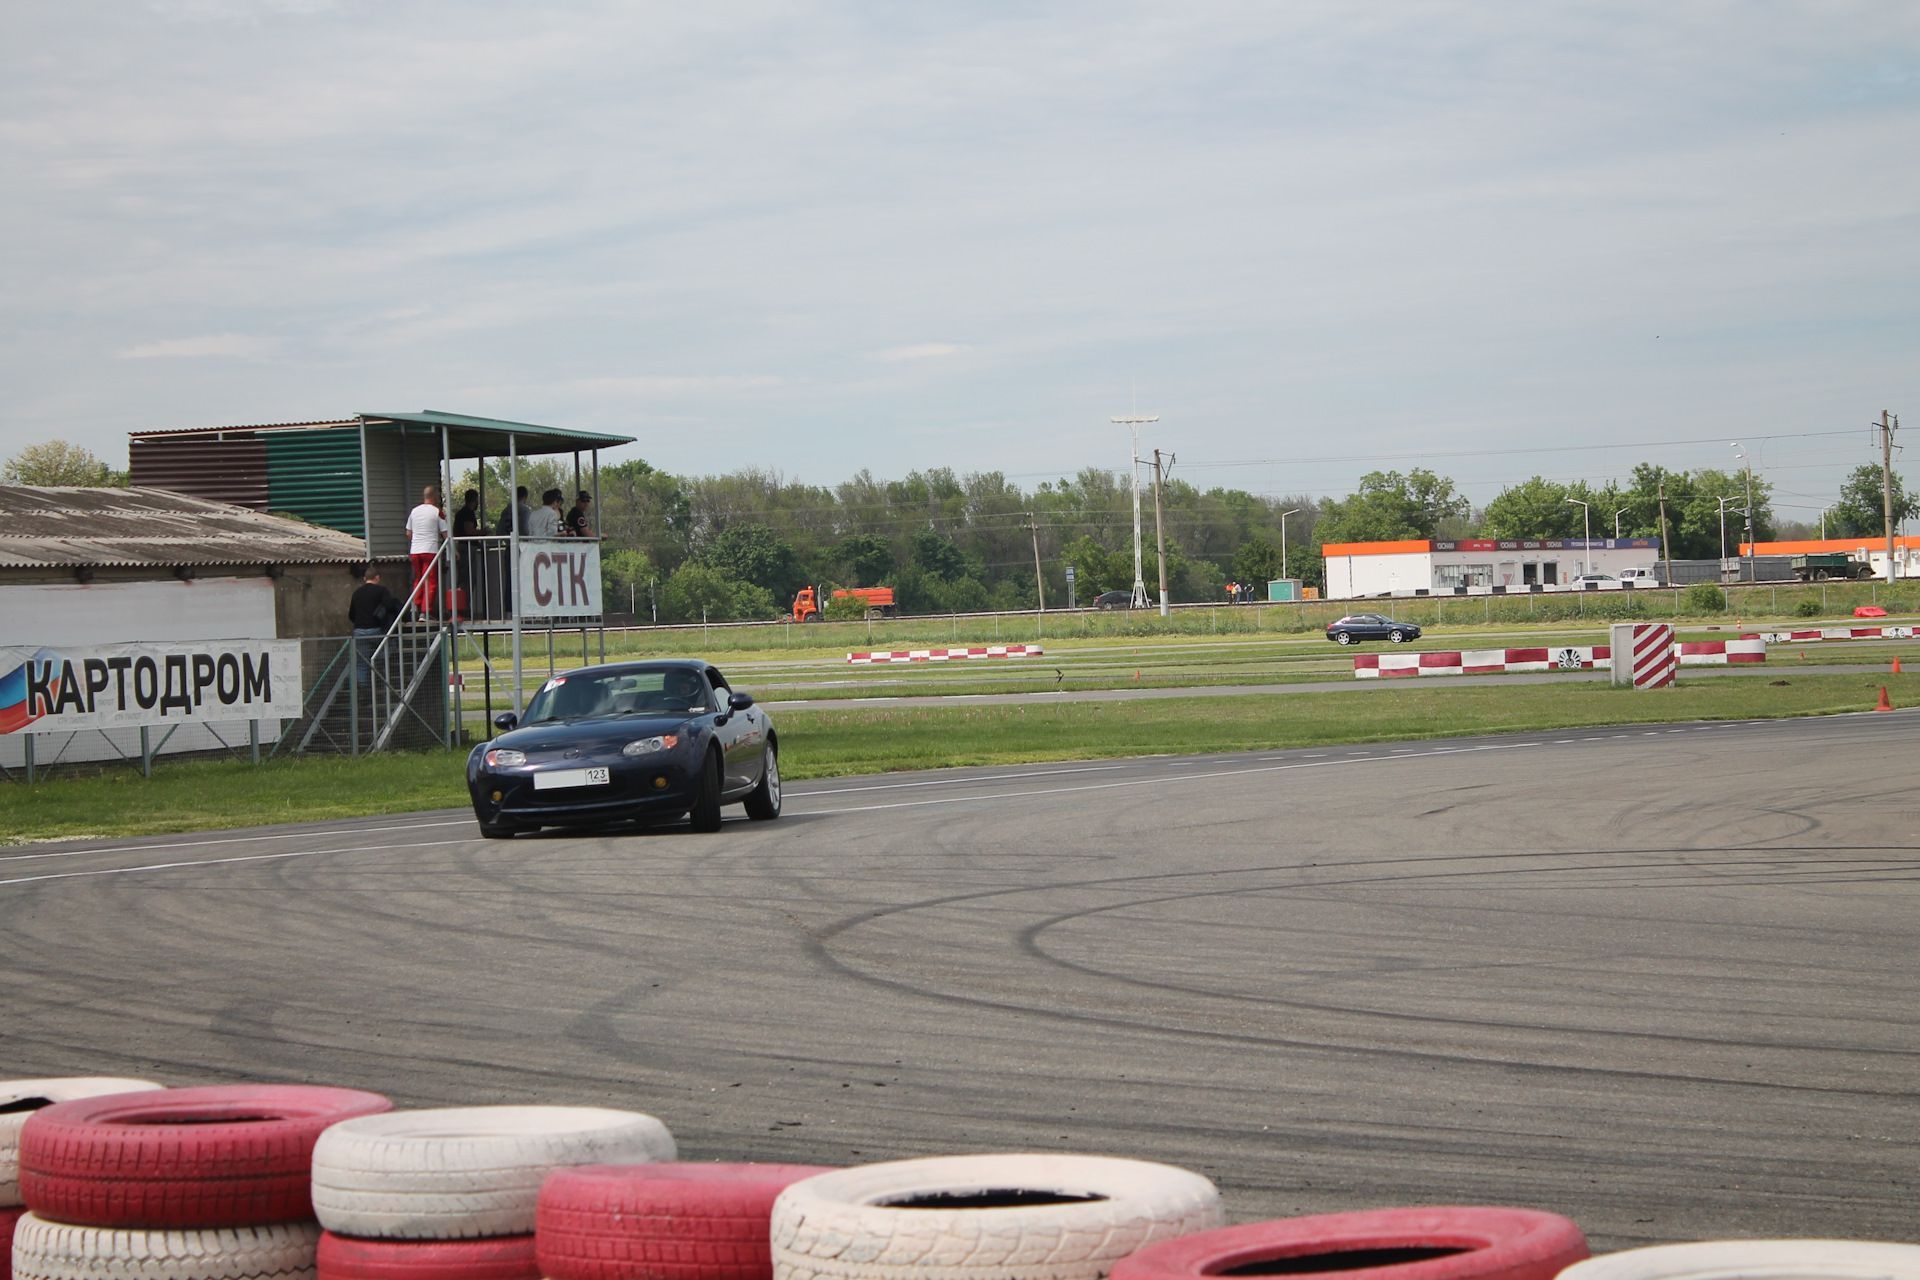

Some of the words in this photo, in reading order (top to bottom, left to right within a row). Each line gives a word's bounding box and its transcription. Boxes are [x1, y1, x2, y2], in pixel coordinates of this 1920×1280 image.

[533, 552, 589, 606] СТК
[26, 652, 271, 716] КАРТОДРОМ
[587, 769, 606, 780] 123
